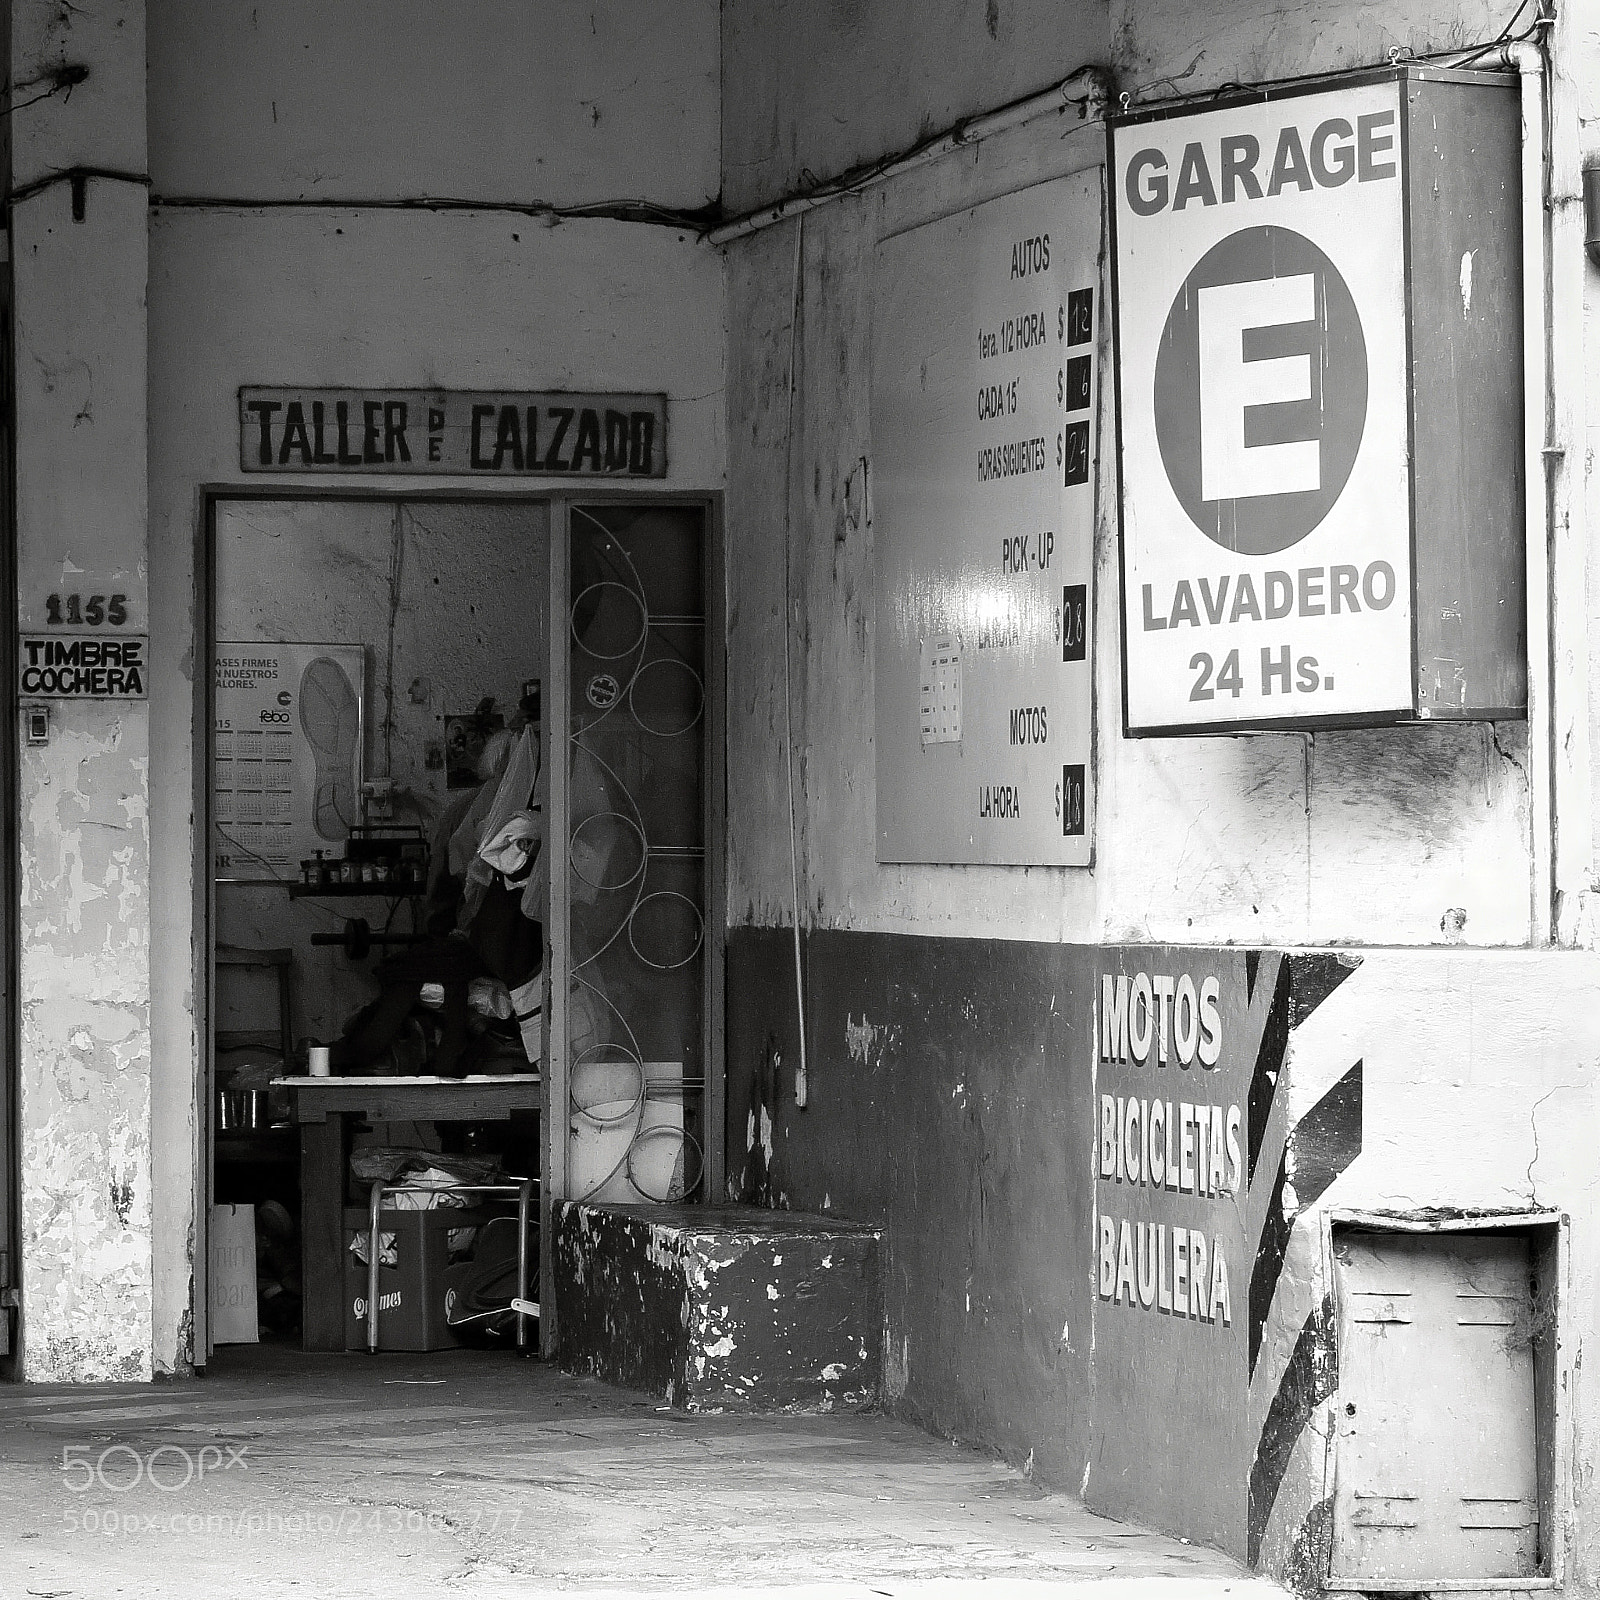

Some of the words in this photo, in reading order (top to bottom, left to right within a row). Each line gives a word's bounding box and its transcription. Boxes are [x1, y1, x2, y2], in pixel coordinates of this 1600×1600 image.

[1125, 110, 1396, 216] GARAGE
[1011, 234, 1050, 280] AUTOS
[978, 328, 998, 360] 1era.
[1001, 320, 1013, 353] 1/2
[1016, 312, 1046, 350] HORA
[1058, 304, 1064, 343] $
[1073, 300, 1089, 337] 12
[978, 385, 1004, 420] CADA
[1057, 368, 1063, 407] $
[1082, 368, 1087, 395] 6
[1198, 272, 1321, 502] E
[248, 401, 411, 465] TALLER
[429, 407, 444, 462] DE
[471, 404, 655, 474] CALZADO
[978, 446, 1002, 482] HORAS
[1003, 437, 1045, 477] SIGUIENTES
[1056, 432, 1062, 470] $
[1003, 535, 1028, 574] PICK
[1039, 532, 1054, 569] UP
[46, 594, 127, 626] 1155
[1142, 560, 1396, 631] LAVADERO
[24, 640, 143, 668] TIMBRE
[215, 658, 240, 668] ASES
[242, 659, 278, 668] FIRMES
[215, 669, 222, 679] N
[224, 669, 278, 679] NUESTROS
[1188, 648, 1244, 702] 24
[1260, 644, 1335, 696] Hs.
[21, 667, 143, 695] COCHERA
[215, 679, 257, 689] ALORES.
[215, 719, 231, 729] 15
[259, 709, 290, 723] febo
[1010, 706, 1048, 745] MOTOS
[980, 786, 991, 818] LA
[993, 786, 1020, 818] HORA
[1055, 782, 1060, 821] $
[1101, 971, 1222, 1071] MOTOS
[1101, 1094, 1243, 1199] BICICLETAS
[1099, 1215, 1232, 1328] BAULERA
